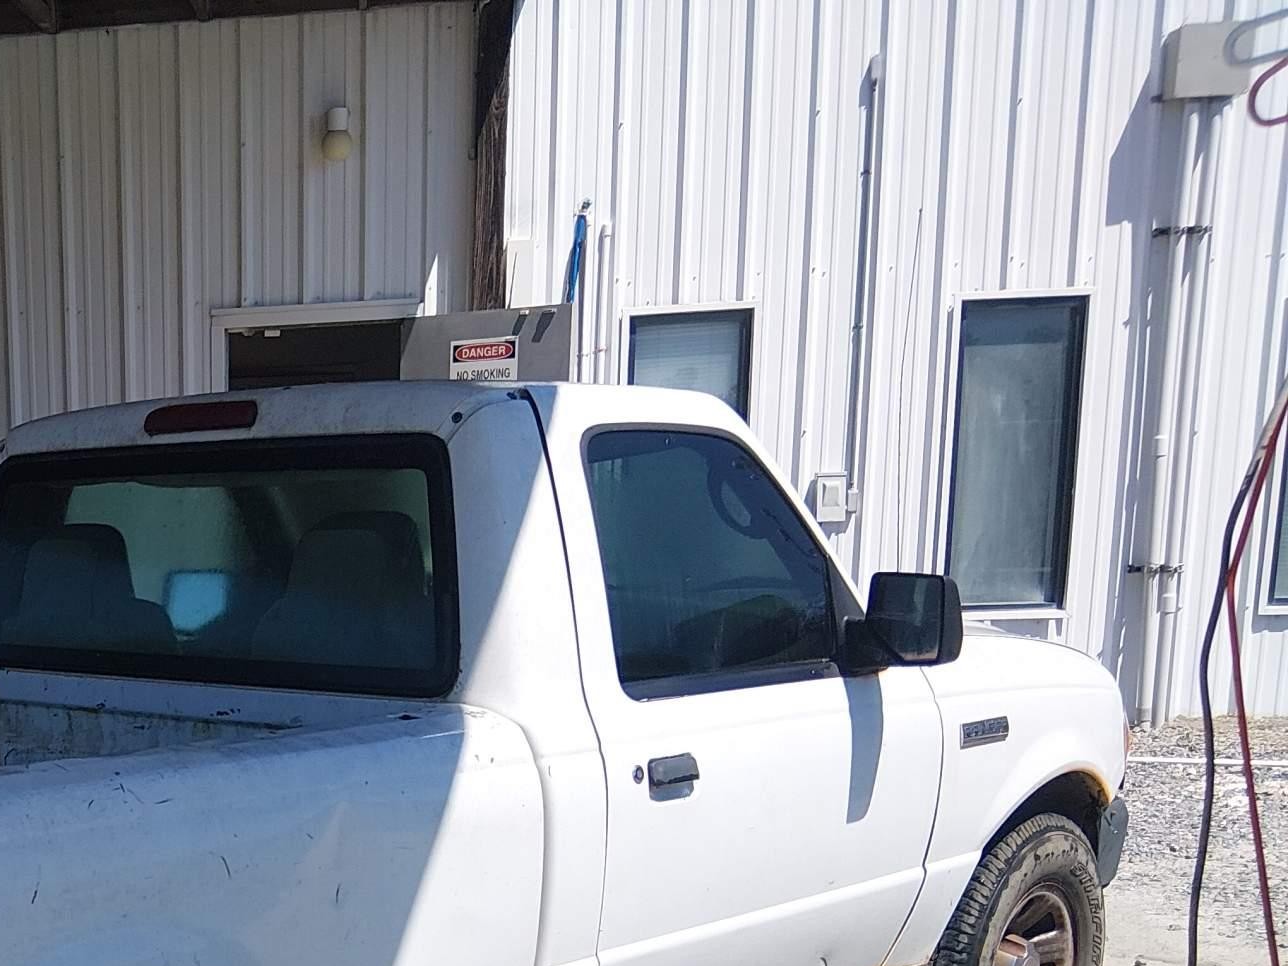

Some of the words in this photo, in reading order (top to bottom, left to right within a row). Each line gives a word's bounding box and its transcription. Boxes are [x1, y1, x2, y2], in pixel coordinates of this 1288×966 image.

[462, 345, 506, 358] DANGER
[456, 370, 469, 381] NO
[470, 367, 511, 380] SMOKING
